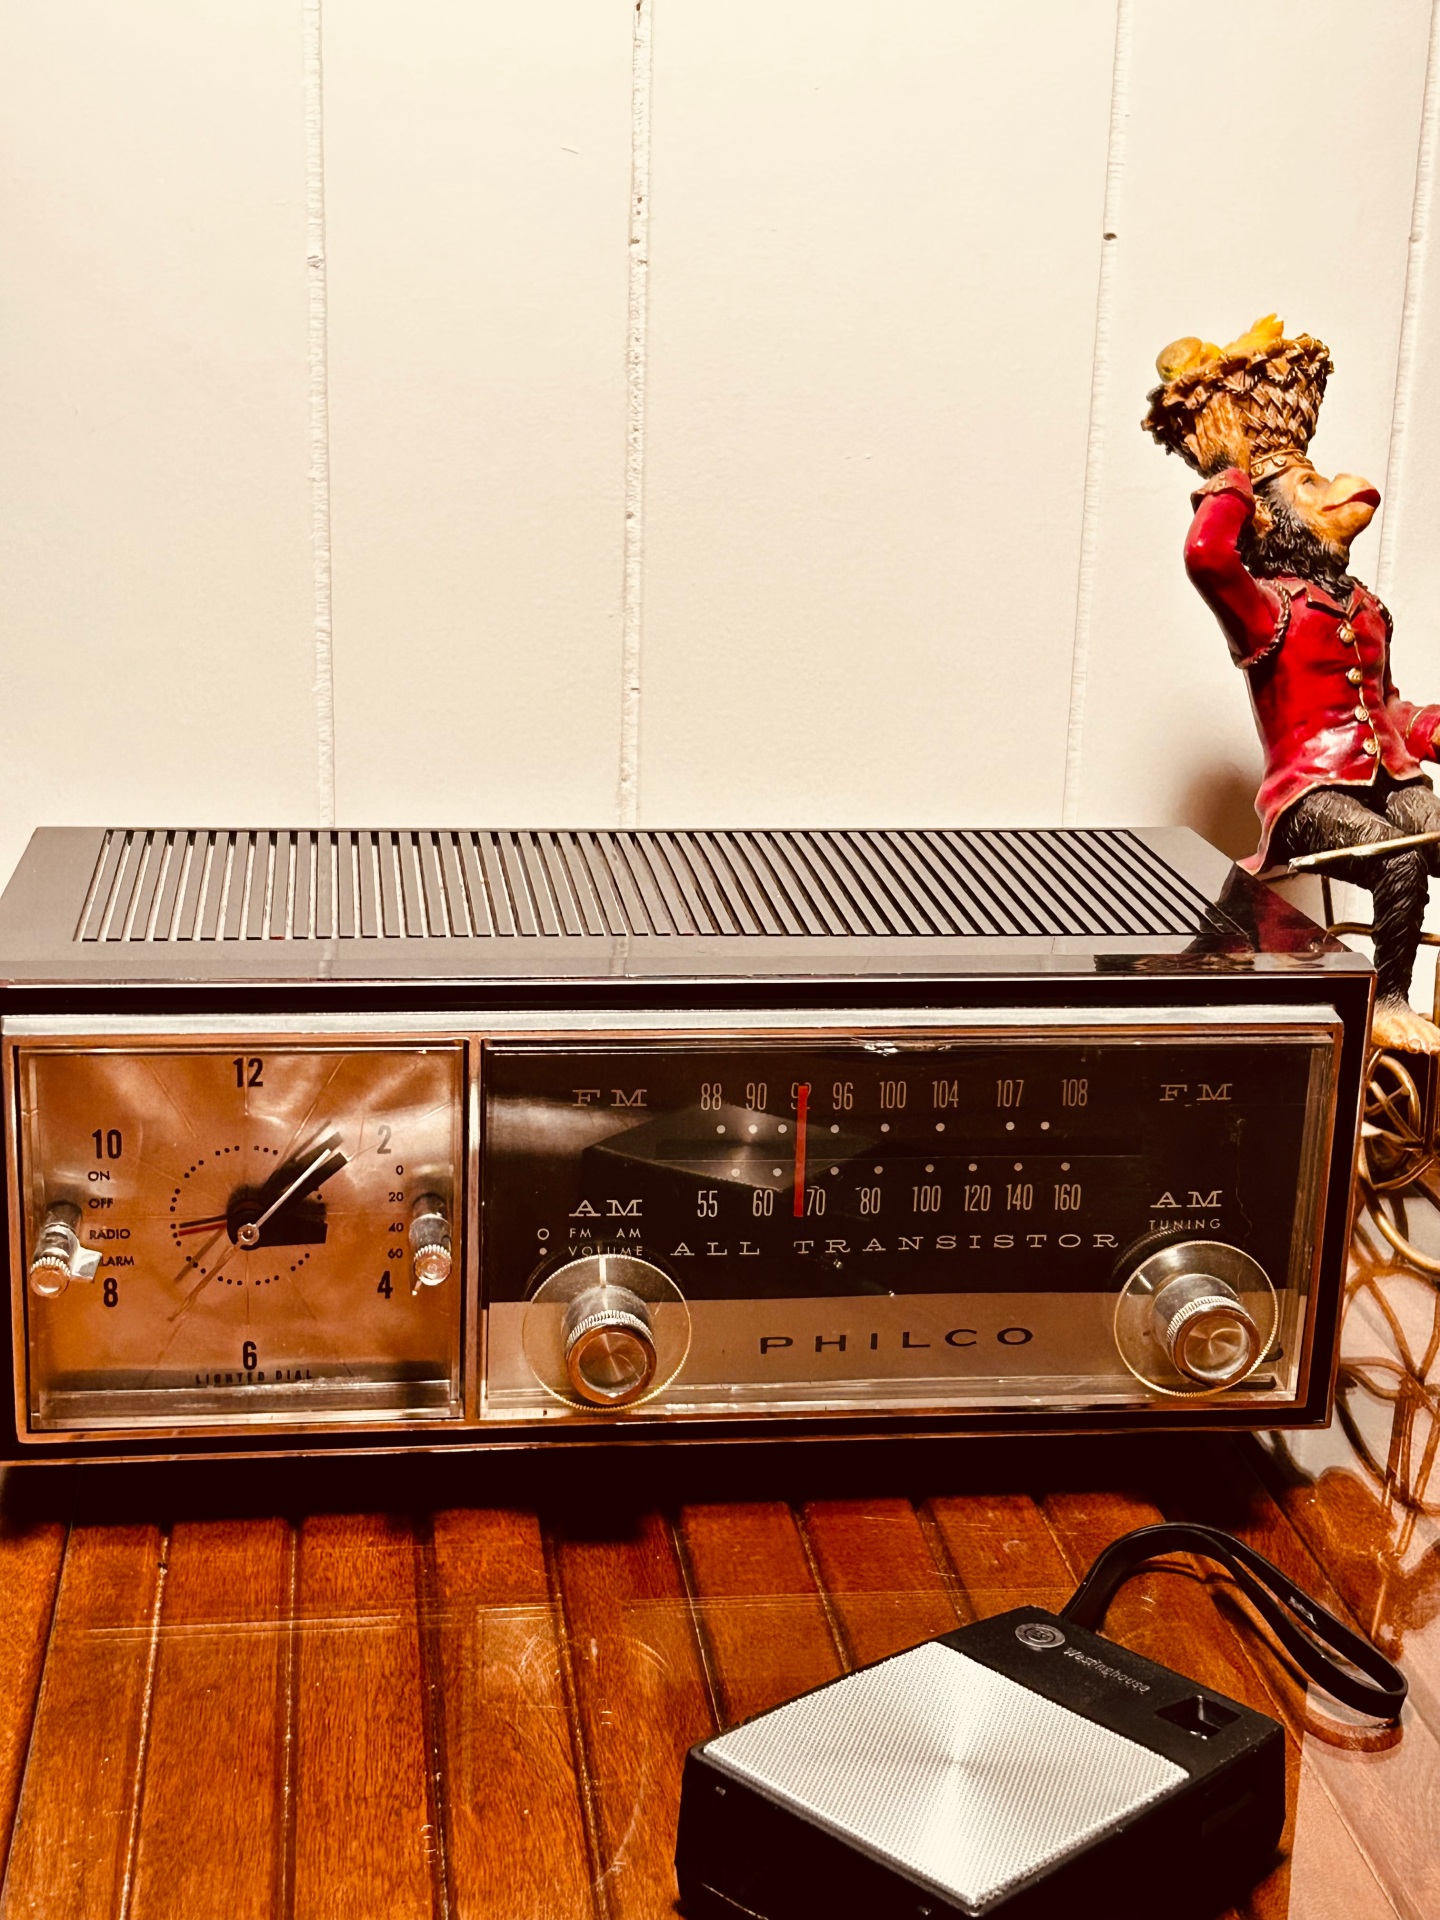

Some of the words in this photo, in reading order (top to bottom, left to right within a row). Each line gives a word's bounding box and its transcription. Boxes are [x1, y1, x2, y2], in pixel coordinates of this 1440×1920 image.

[233, 1057, 263, 1088] 12
[572, 1089, 647, 1107] FM
[701, 1083, 722, 1110] 88
[746, 1083, 767, 1110] 90
[833, 1082, 854, 1110] 96
[880, 1081, 907, 1109] 100
[932, 1080, 959, 1108] 104
[997, 1079, 1024, 1108] 107
[1061, 1078, 1089, 1107] 108
[1159, 1083, 1233, 1101] FM
[92, 1129, 122, 1159] 10
[377, 1125, 392, 1154] 2
[87, 1170, 111, 1182] ON
[395, 1165, 404, 1175] 0
[88, 1198, 113, 1208] OFF
[388, 1192, 404, 1202] 20
[697, 1190, 718, 1218] 55
[752, 1189, 774, 1217] 60
[806, 1188, 826, 1216] 70
[860, 1187, 881, 1214] 80
[912, 1185, 942, 1212] 100
[964, 1184, 992, 1212] 120
[1005, 1183, 1034, 1211] 140
[1054, 1183, 1082, 1211] 160
[1150, 1190, 1223, 1208] AM
[569, 1199, 643, 1217] AM
[388, 1223, 404, 1233] 40
[569, 1228, 592, 1238] FM
[616, 1228, 641, 1238] AM
[1149, 1219, 1221, 1231] TUNING
[89, 1229, 131, 1240] RADIO
[388, 1248, 403, 1259] 60
[670, 1241, 760, 1256] ALL
[793, 1234, 1119, 1254] TRANSISTOR
[98, 1256, 135, 1267] LARM
[103, 1278, 118, 1307] 8
[377, 1271, 393, 1299] 4
[759, 1327, 1034, 1355] PHILCO
[242, 1340, 258, 1371] 6
[195, 1371, 265, 1385] LIGHTED
[275, 1369, 313, 1380] DIAL
[1063, 1647, 1151, 1693] Westinghouse
